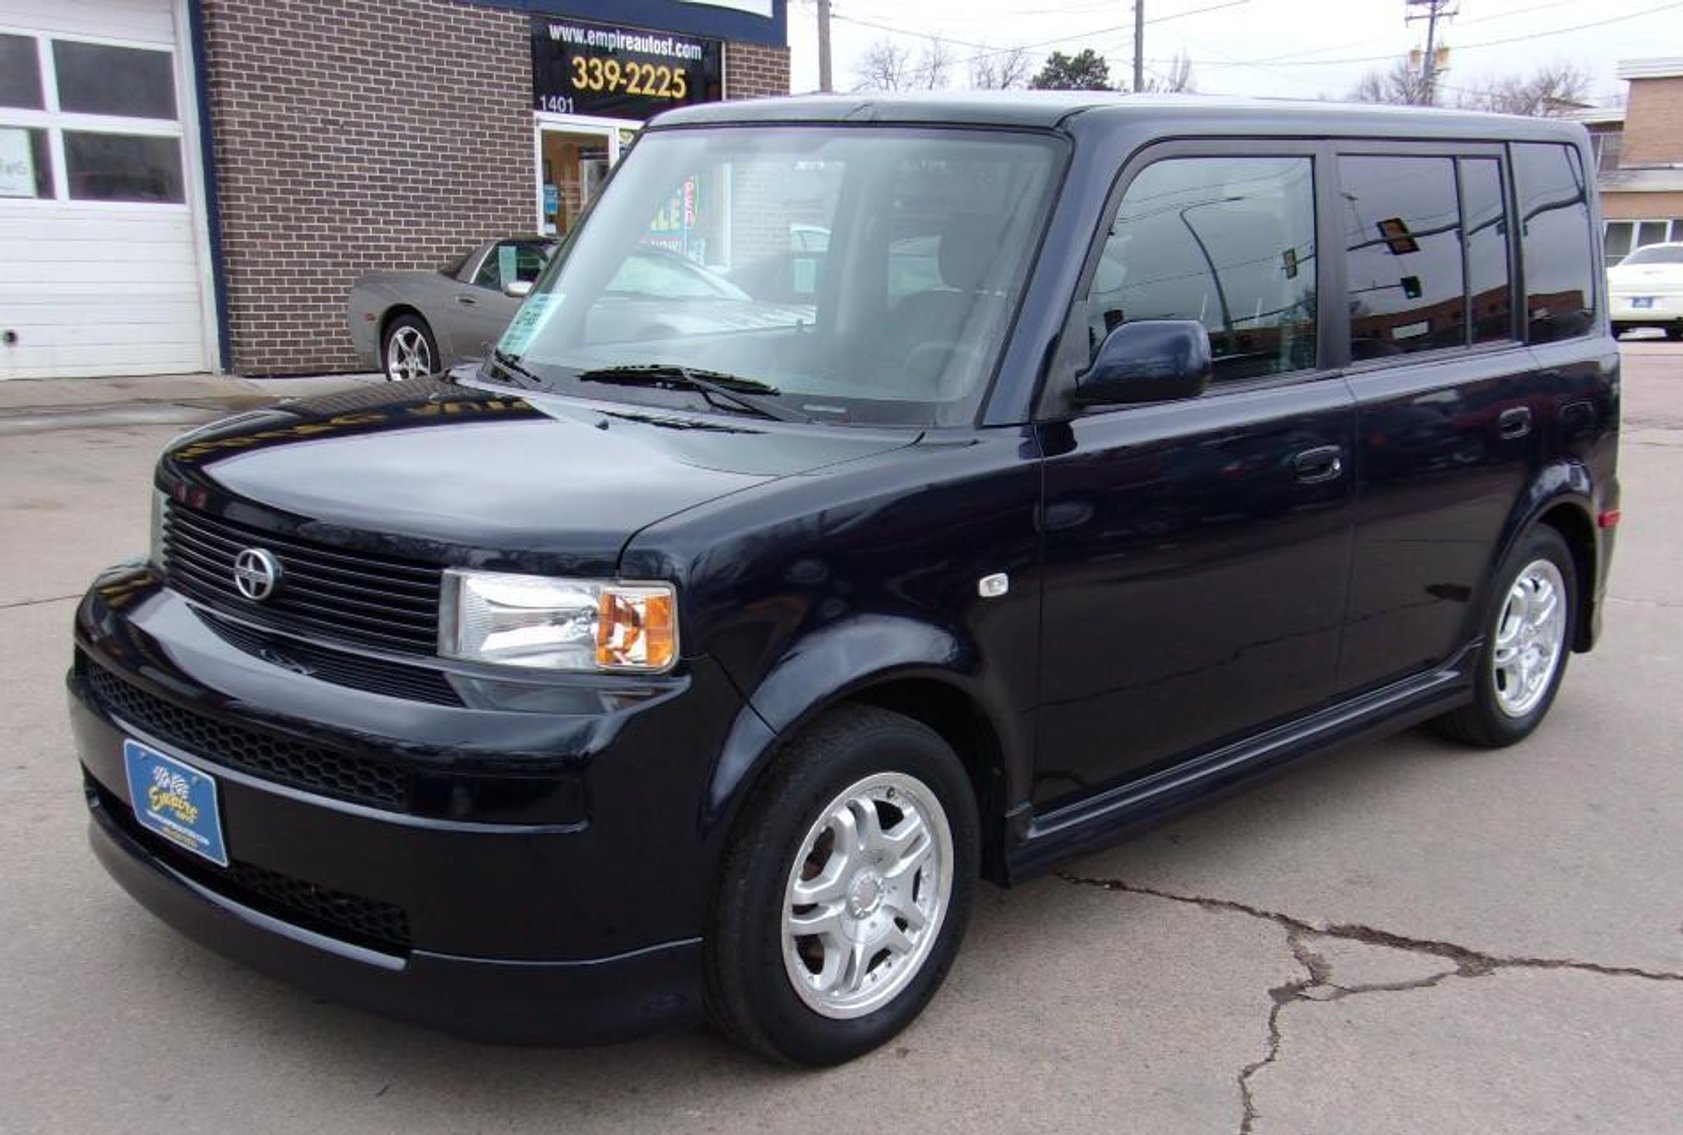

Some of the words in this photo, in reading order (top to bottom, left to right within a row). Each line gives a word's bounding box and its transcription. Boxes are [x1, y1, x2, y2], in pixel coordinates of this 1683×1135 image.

[549, 24, 701, 59] www.empireautosf.com
[572, 56, 687, 98] 339-2225
[540, 95, 574, 113] 1401
